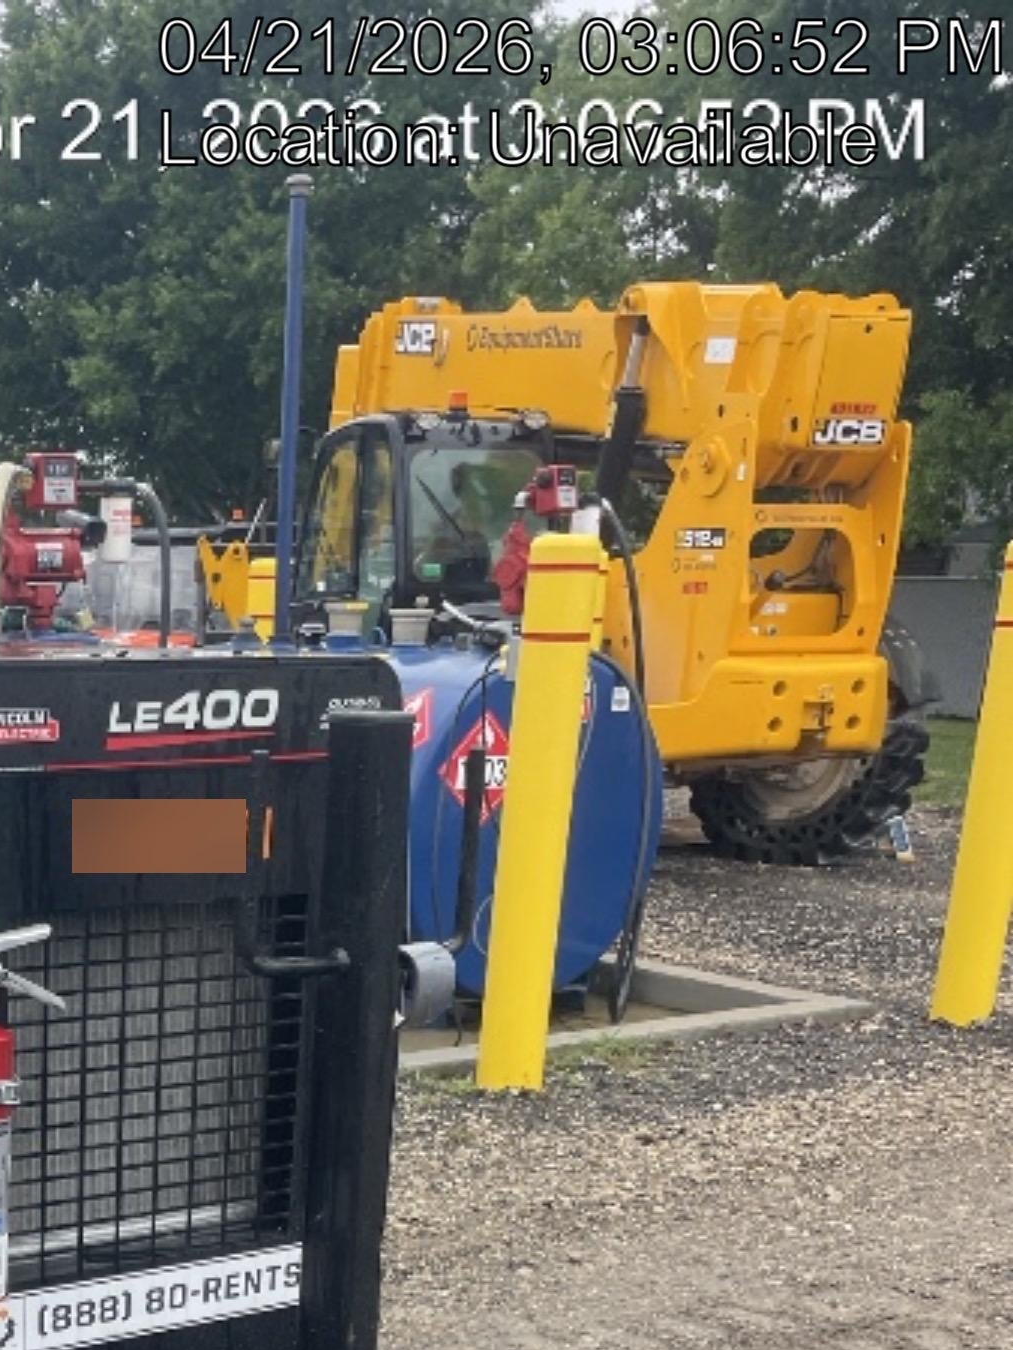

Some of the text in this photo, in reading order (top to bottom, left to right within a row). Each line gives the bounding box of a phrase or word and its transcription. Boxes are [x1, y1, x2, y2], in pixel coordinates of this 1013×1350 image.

[813, 419, 885, 444] JCB
[108, 689, 279, 732] LE400
[461, 758, 507, 787] 103
[37, 1262, 302, 1336] (888) 80-RENTS
